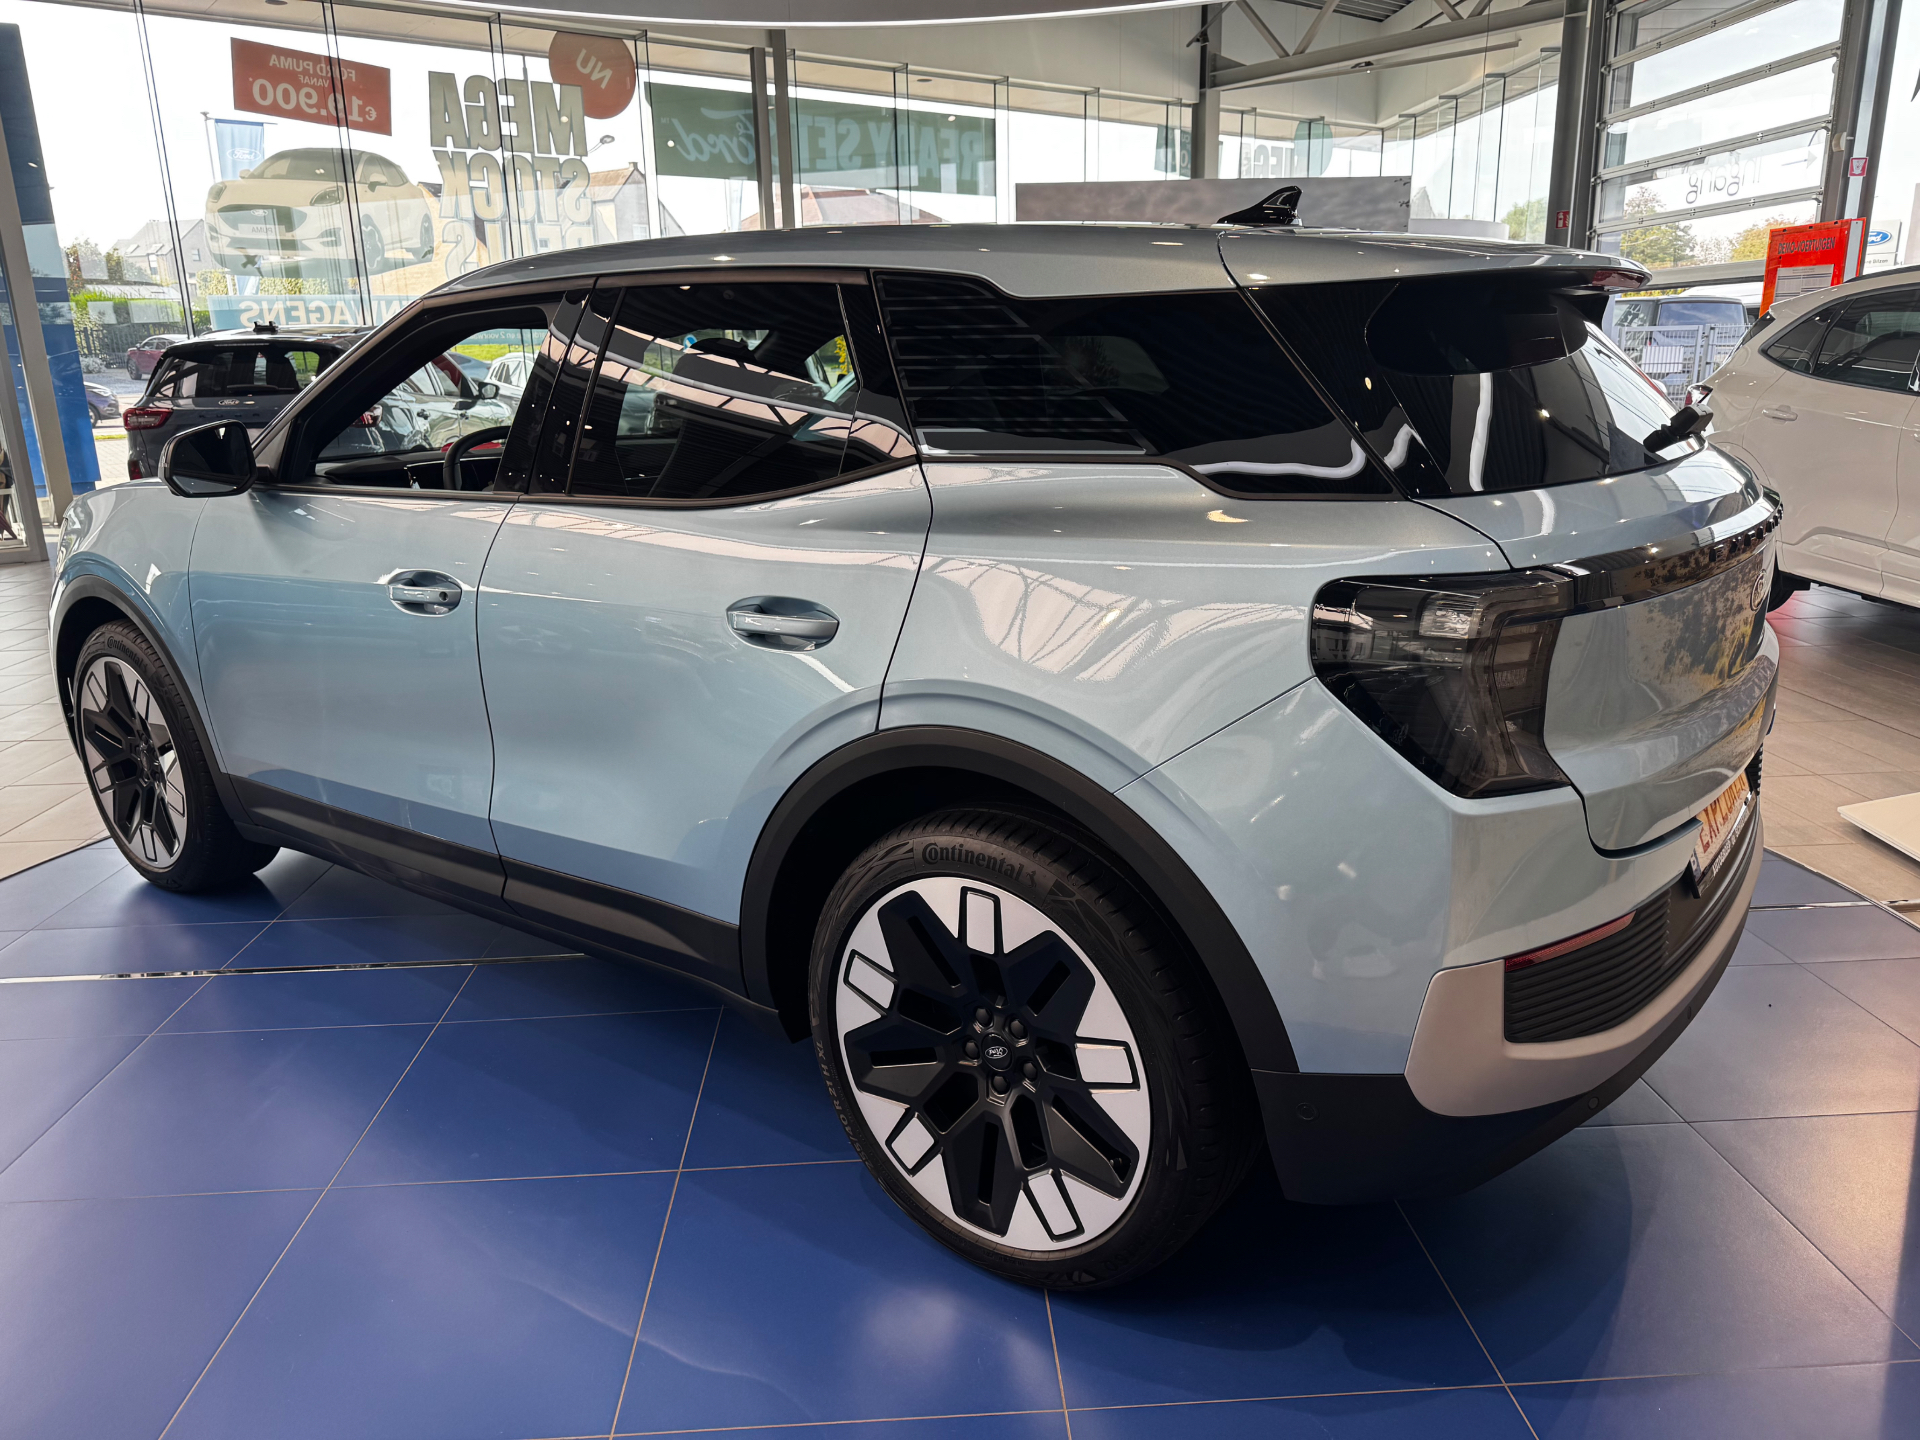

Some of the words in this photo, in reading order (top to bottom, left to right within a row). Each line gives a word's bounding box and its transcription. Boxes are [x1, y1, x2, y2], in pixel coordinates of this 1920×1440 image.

[1778, 236, 1836, 255] DEMO-VOERTUIGEN
[107, 635, 144, 668] Continental
[922, 842, 1025, 881] Continental
[833, 1099, 843, 1112] R
